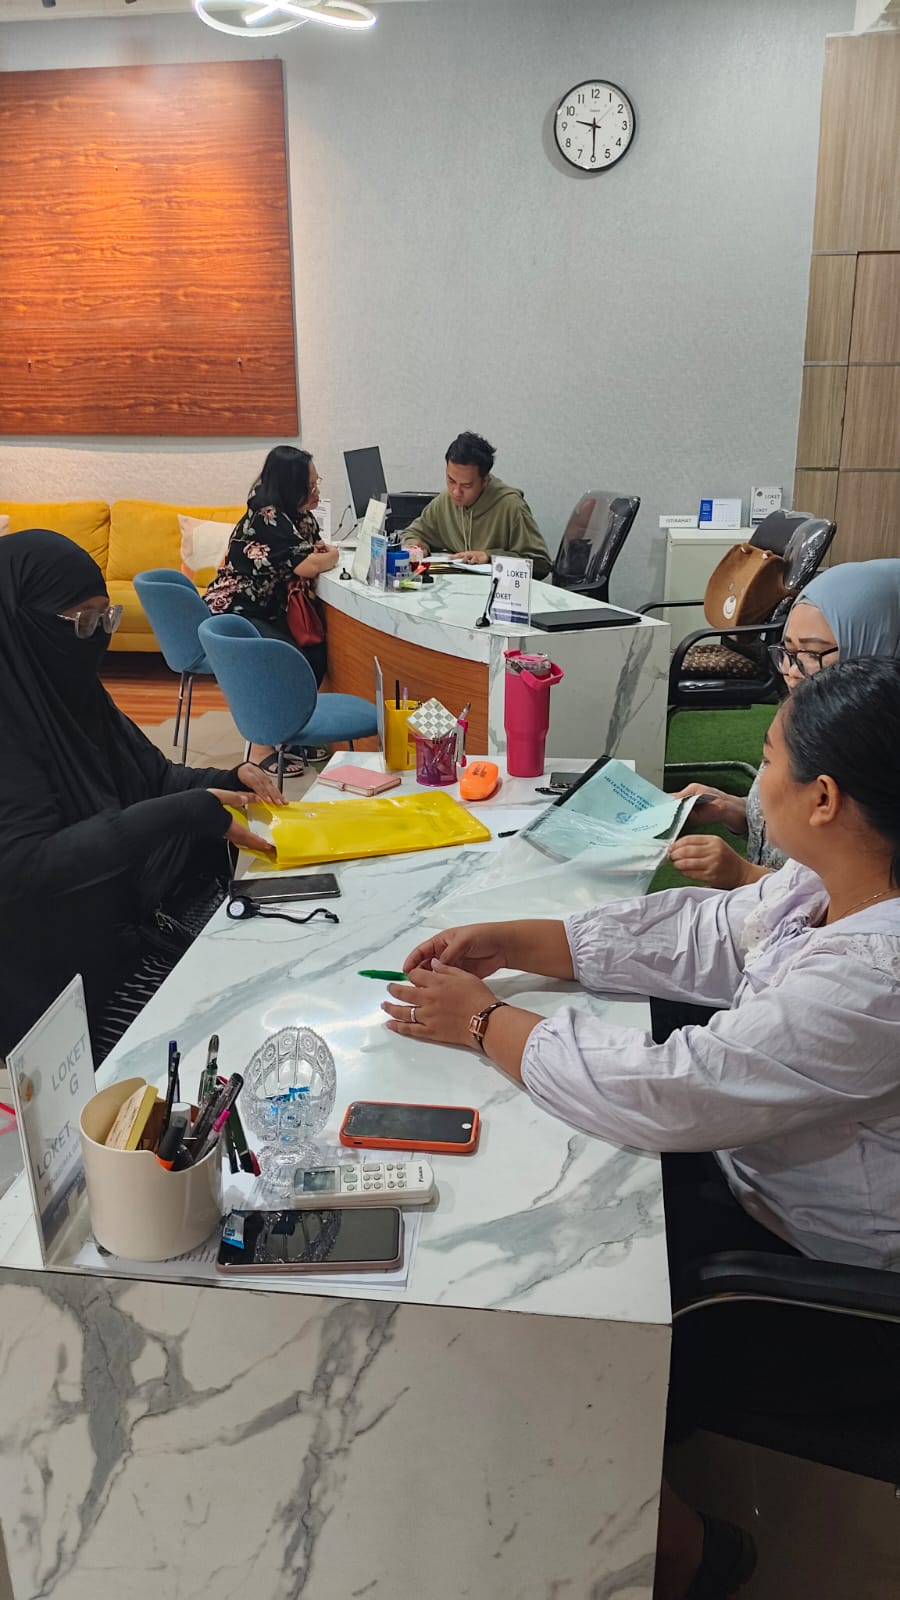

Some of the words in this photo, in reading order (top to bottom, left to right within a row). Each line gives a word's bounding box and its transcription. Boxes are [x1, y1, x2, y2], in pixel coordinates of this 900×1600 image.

[578, 94, 585, 104] 11
[591, 88, 600, 99] 12
[566, 105, 576, 116] 10
[617, 103, 624, 114] 2
[561, 121, 568, 132] 9
[621, 120, 628, 131] 3
[565, 137, 572, 148] 8
[615, 137, 622, 147] 4
[577, 148, 583, 160] 7
[604, 148, 611, 159] 5
[506, 570, 528, 579] LOKET
[514, 580, 520, 588] B
[494, 592, 512, 600] OKET
[52, 1033, 86, 1092] LOKET
[69, 1072, 79, 1096] G
[37, 1119, 71, 1180] LOKET
